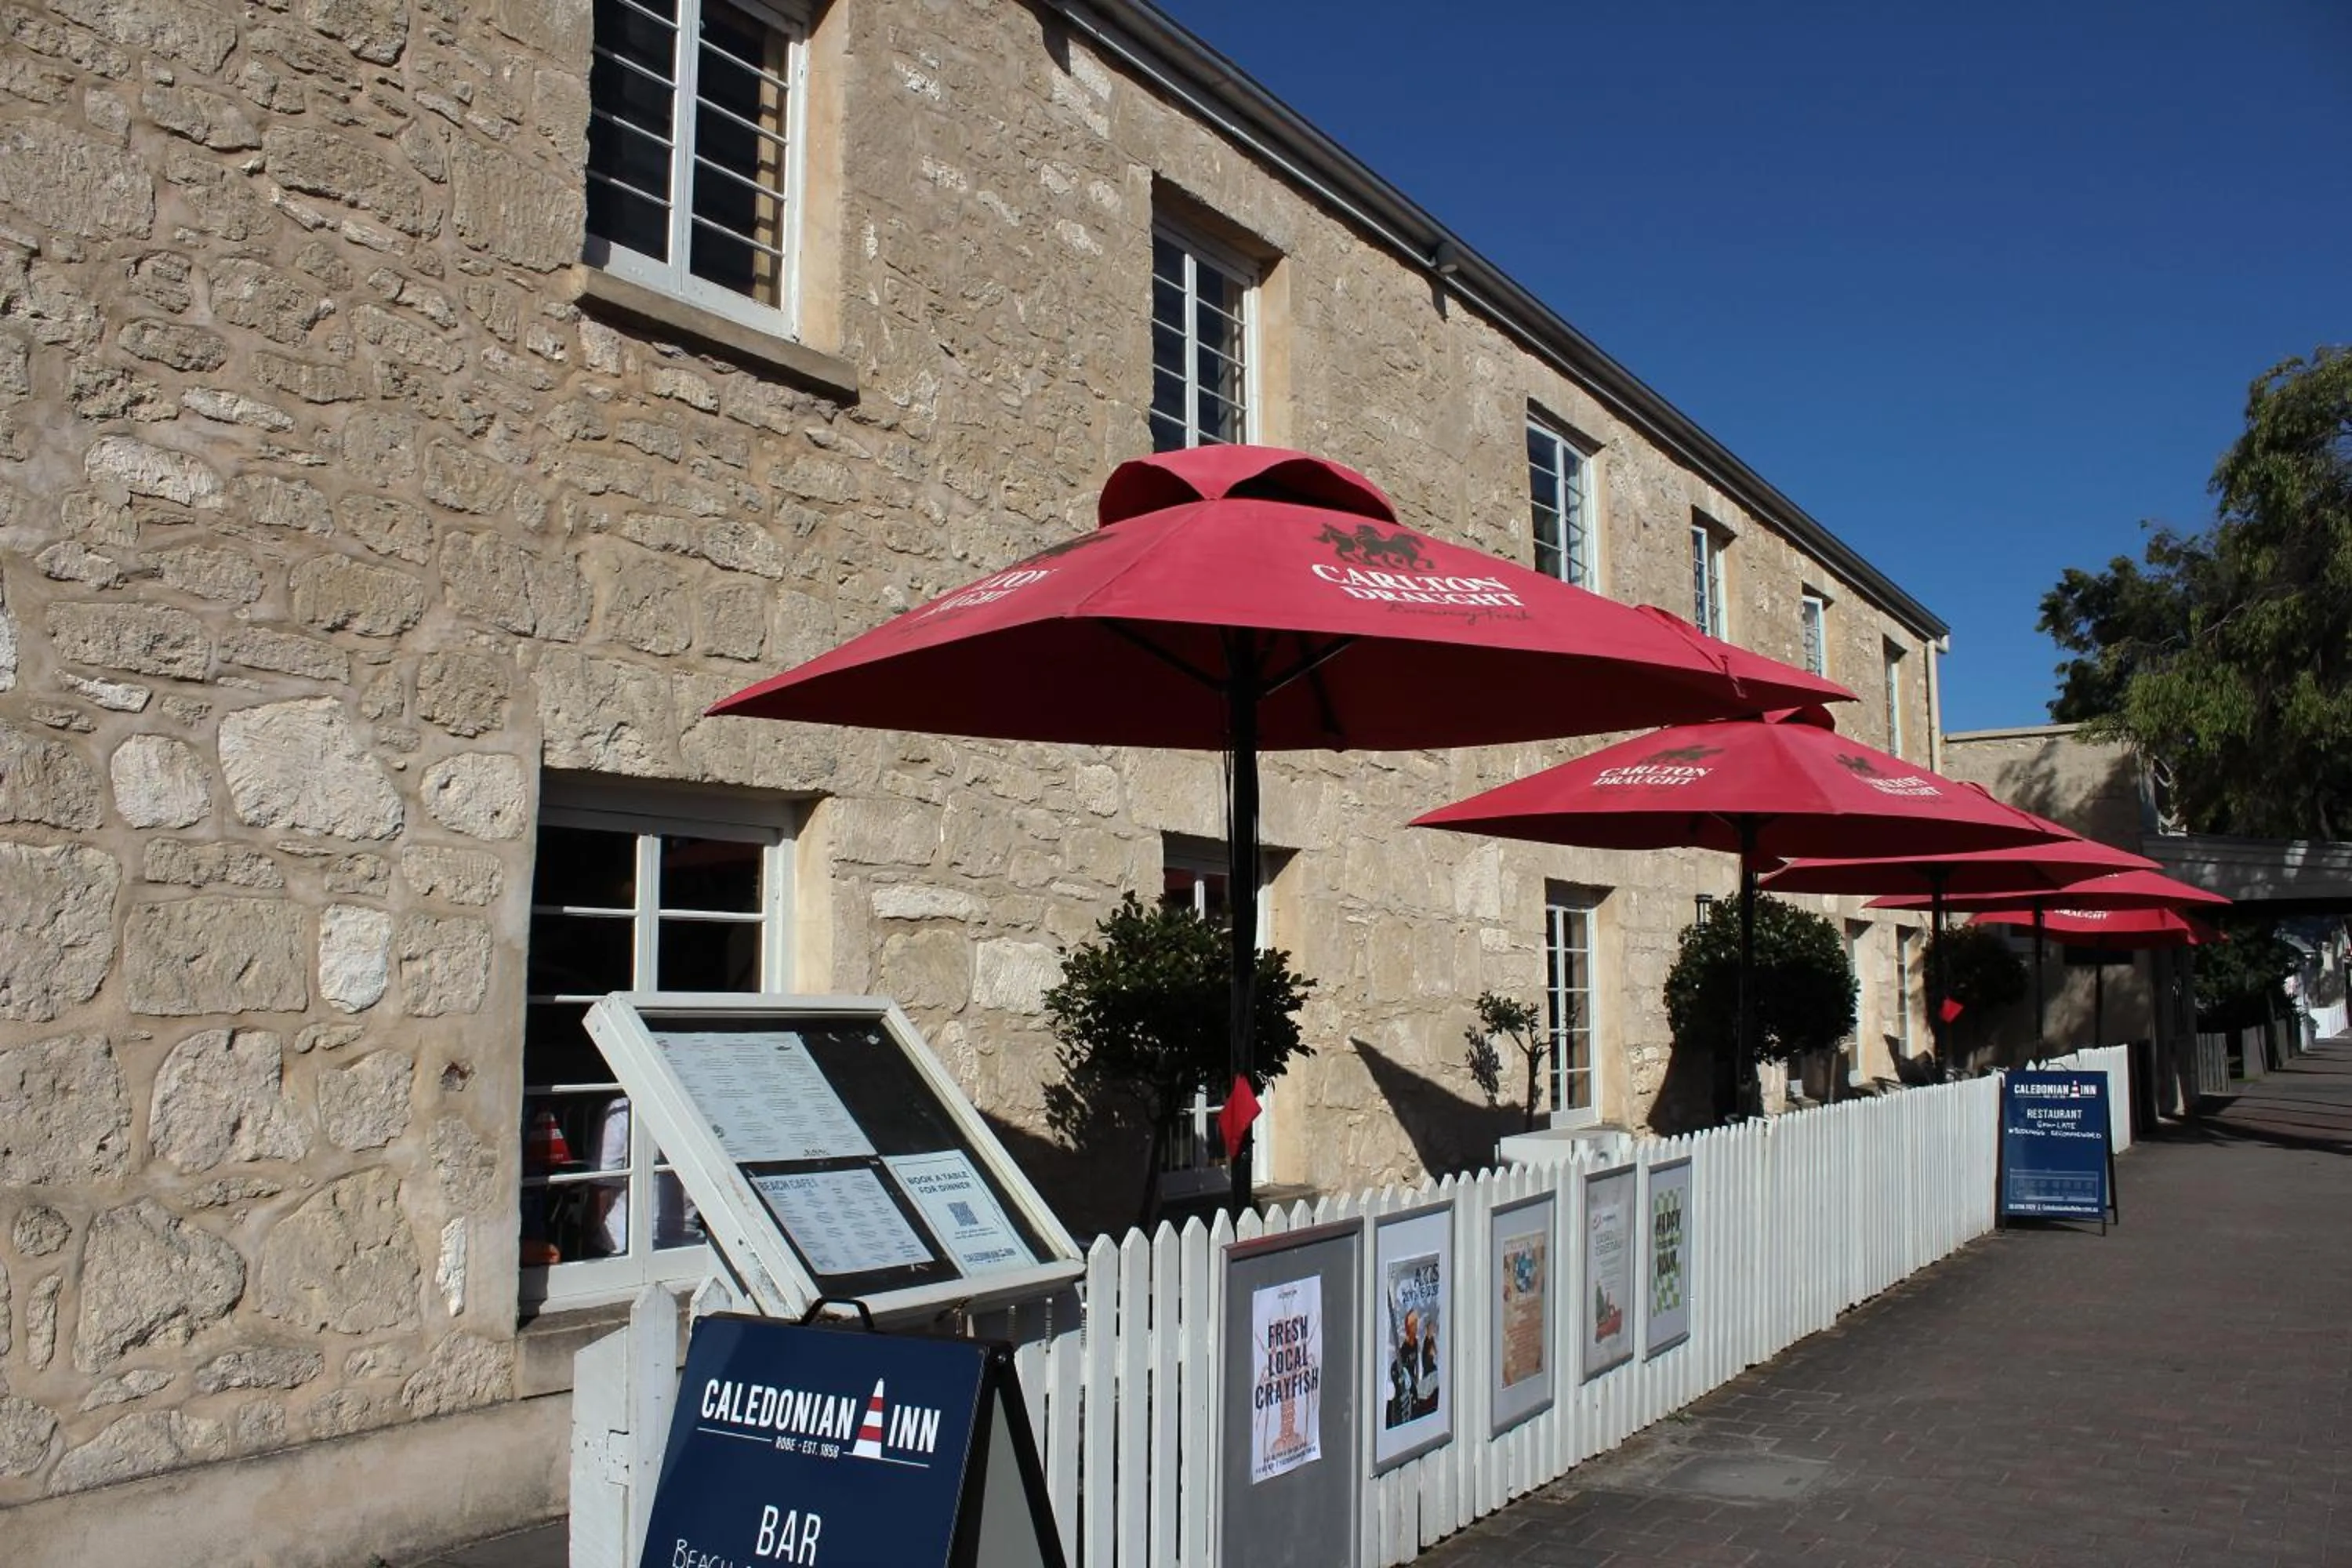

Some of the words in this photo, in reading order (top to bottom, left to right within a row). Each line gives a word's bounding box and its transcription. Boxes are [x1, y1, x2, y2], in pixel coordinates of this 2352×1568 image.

[1312, 564, 1512, 591] CARLTON
[1340, 586, 1524, 607] DRAUGHT
[1592, 775, 1697, 785] DRAUGHT
[1599, 765, 1714, 777] CARLTON
[2014, 1084, 2069, 1094] CALEDONIAN
[2080, 1085, 2097, 1095] INN
[2027, 1108, 2082, 1119] RESTAURANT
[906, 1175, 934, 1185] BOOK
[1268, 1315, 1308, 1349] FRESH
[1268, 1343, 1308, 1377] LOCAL
[1255, 1367, 1319, 1410] CRAYFISH
[701, 1378, 857, 1440] CALEDONIAN
[887, 1404, 941, 1454] INN
[755, 1504, 822, 1567] BAR
